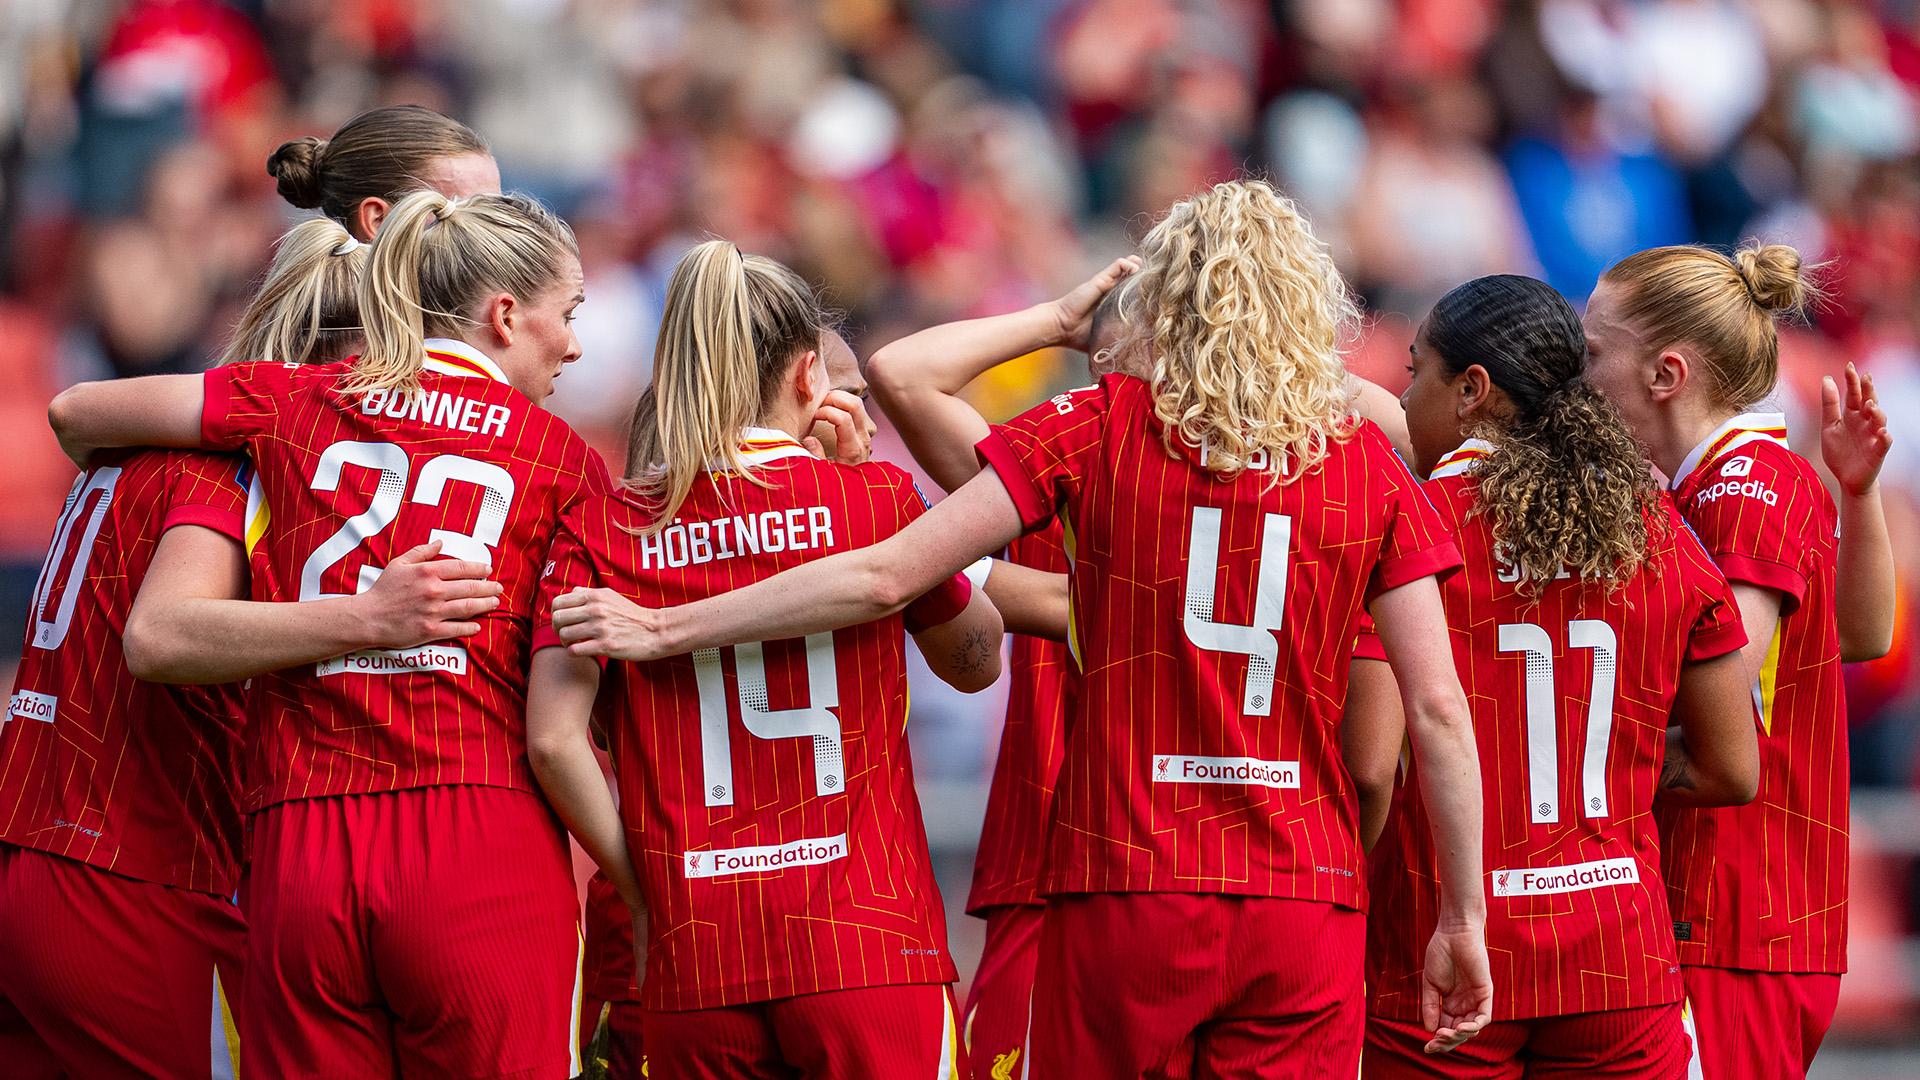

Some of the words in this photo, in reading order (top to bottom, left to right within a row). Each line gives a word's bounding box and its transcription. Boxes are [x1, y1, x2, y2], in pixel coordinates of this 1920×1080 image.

[362, 388, 511, 437] BONNER
[1697, 480, 1778, 508] Expedia
[300, 441, 515, 603] 23
[641, 506, 835, 569] HÖBINGER
[1184, 506, 1292, 717] 4
[344, 649, 459, 669] Foundation
[8, 697, 52, 718] ation
[692, 631, 846, 806] 14
[1183, 761, 1293, 783] Foundation
[714, 843, 840, 871] Foundation
[1523, 865, 1633, 890] Foundation
